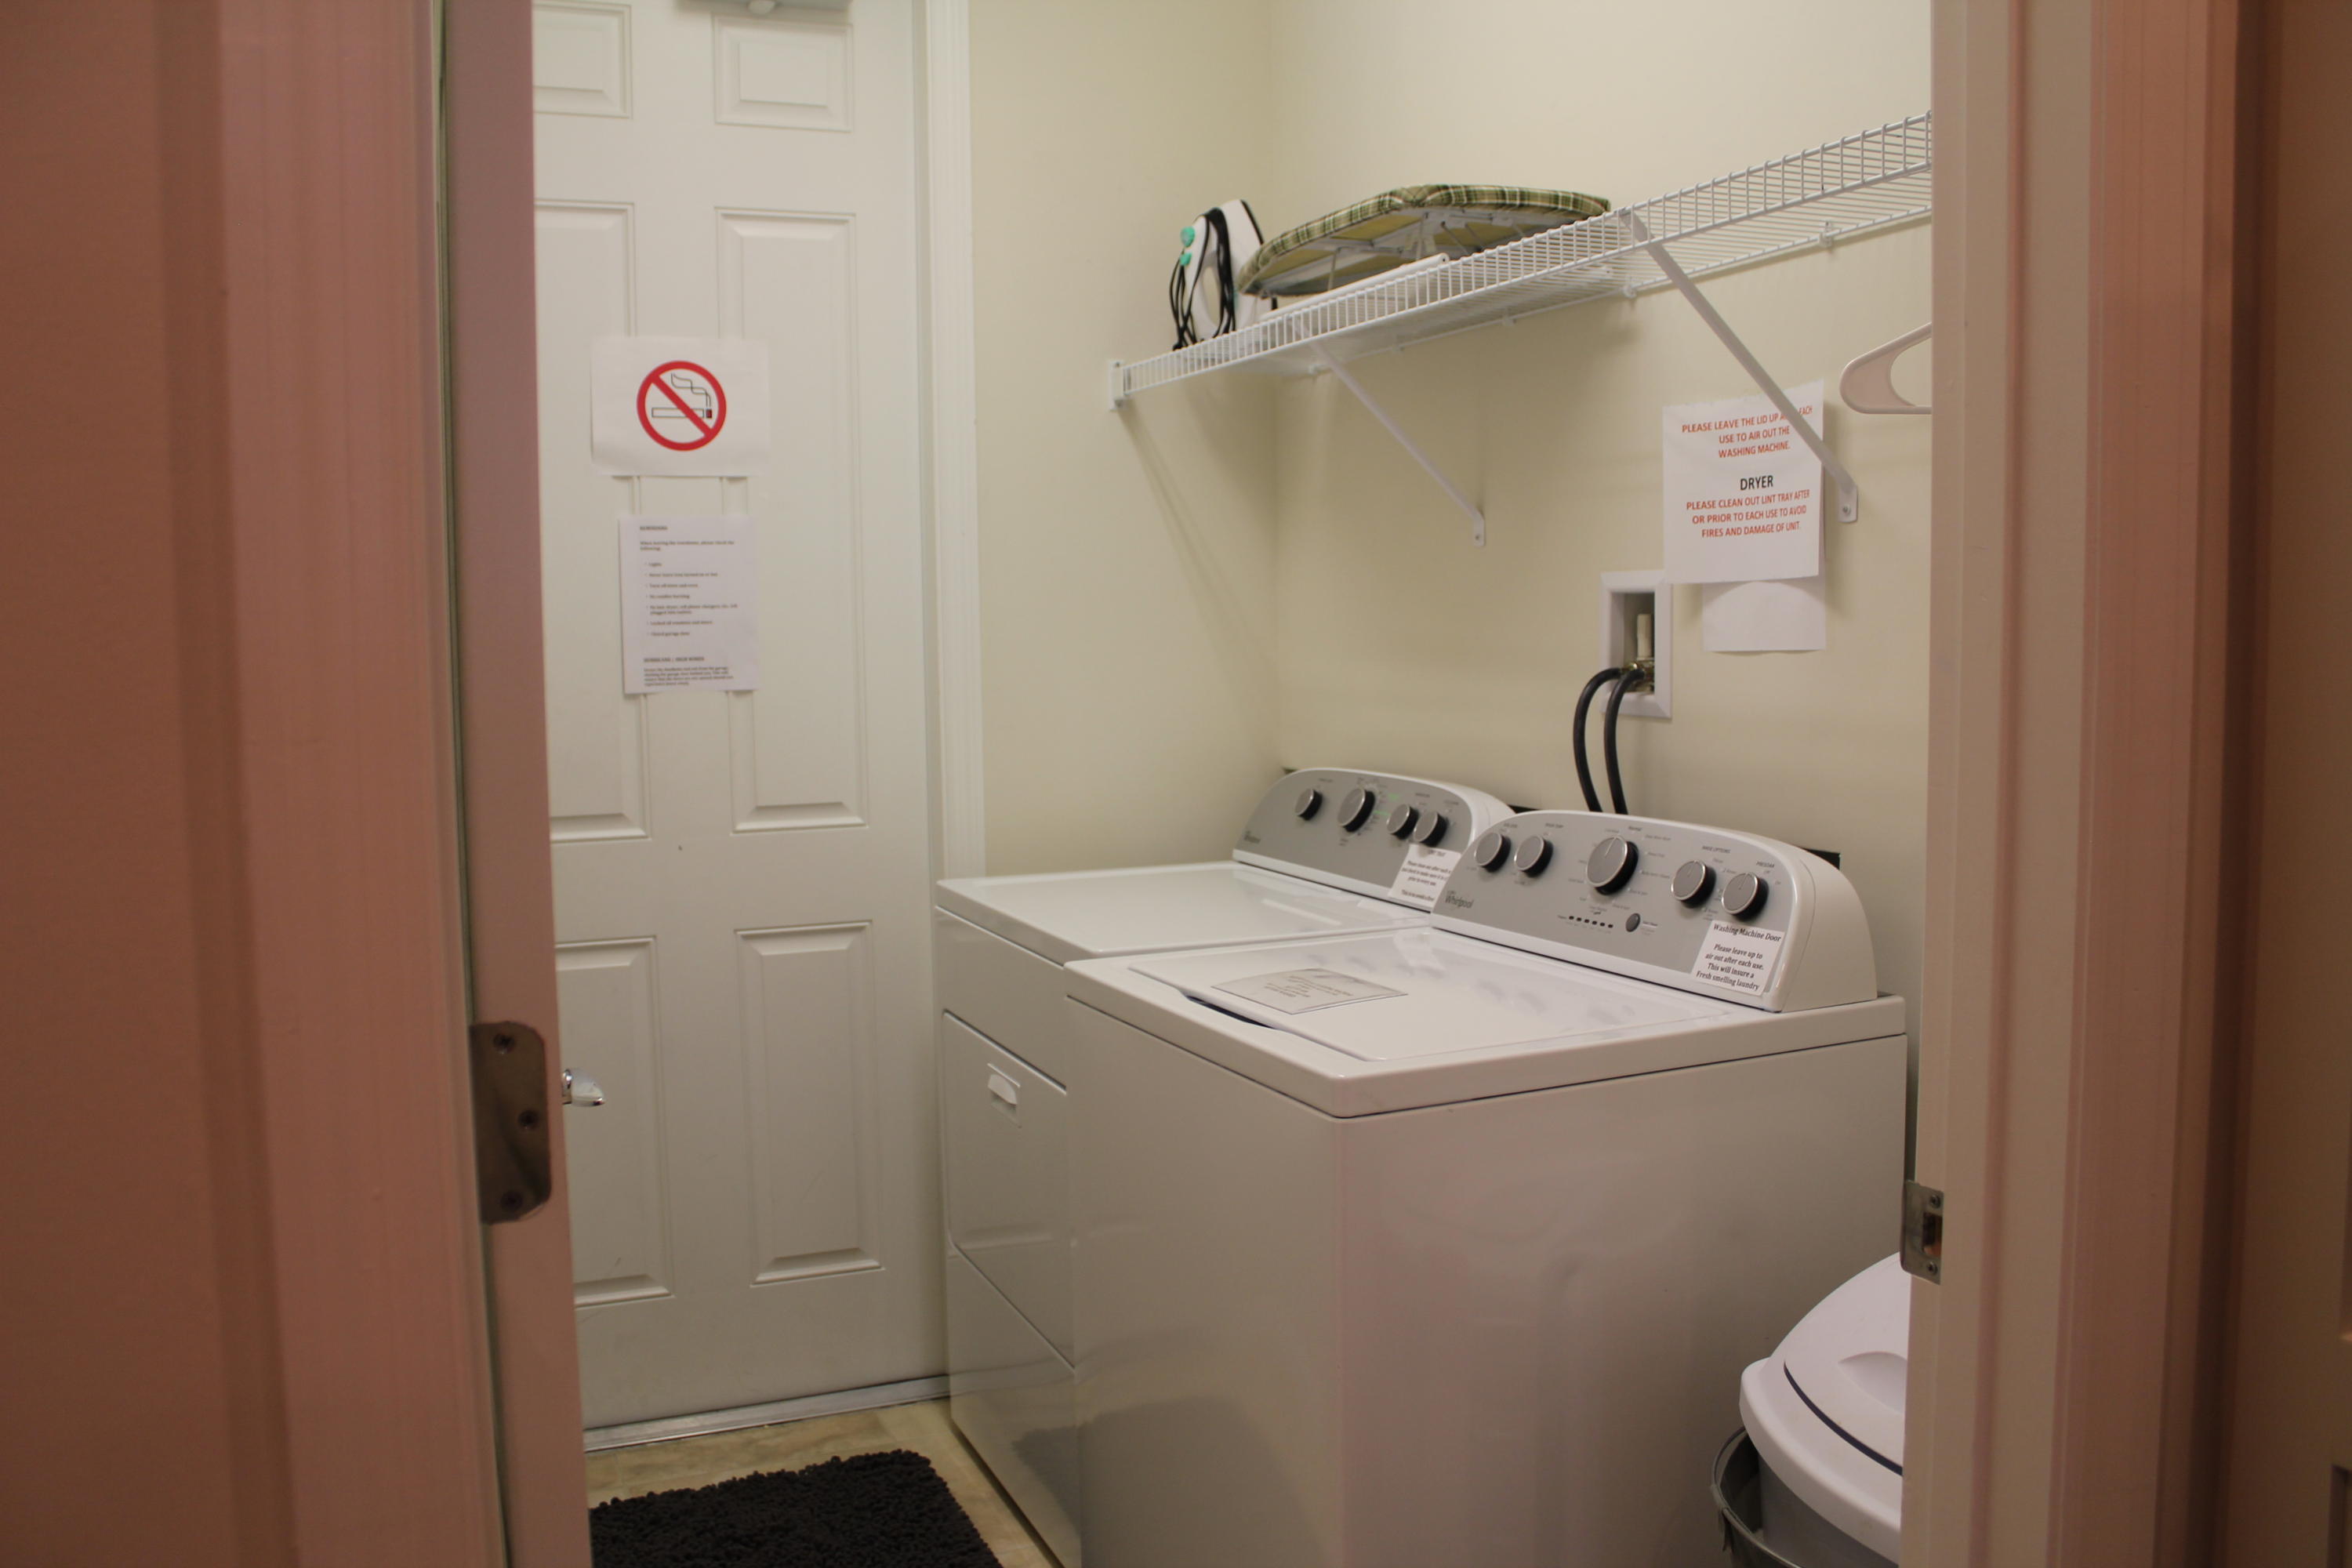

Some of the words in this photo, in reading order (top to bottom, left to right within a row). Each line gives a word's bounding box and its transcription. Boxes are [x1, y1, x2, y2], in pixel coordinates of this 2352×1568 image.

[1682, 423, 1712, 433] PLEASE
[1715, 419, 1738, 430] LEAVE
[1741, 418, 1755, 426] THE
[1769, 413, 1779, 422] UP
[1719, 434, 1733, 444] USE
[1737, 433, 1746, 441] TO
[1749, 431, 1760, 440] AIR
[1762, 429, 1777, 438] OUT
[1779, 426, 1790, 434] THE
[1719, 448, 1755, 458] WASHING
[1740, 475, 1773, 490] DRYER
[1686, 501, 1716, 510] PLEASE
[1719, 499, 1743, 507] CLEAN
[1745, 496, 1759, 506] OUT
[1762, 495, 1776, 504] LINT
[1778, 492, 1792, 502] TRAY
[1795, 489, 1809, 499] AFTER
[1693, 514, 1704, 524] OR
[1708, 513, 1731, 523] PRIOR
[1734, 512, 1744, 521] TO
[1746, 510, 1764, 520] EACH
[1766, 509, 1777, 518] USE
[1780, 507, 1788, 517] TO
[1790, 506, 1806, 515] AVOID
[1701, 528, 1723, 538] FIRES
[1726, 527, 1742, 536] AND
[1744, 524, 1774, 534] DAMAGE
[1777, 524, 1784, 532] OF
[1714, 924, 1739, 935] Washing
[1738, 928, 1764, 938] Machine
[1733, 947, 1746, 956] leave
[1724, 956, 1737, 965] after
[1732, 968, 1749, 978] insure
[1712, 975, 1736, 985] smelling
[1737, 979, 1759, 989] laundry
